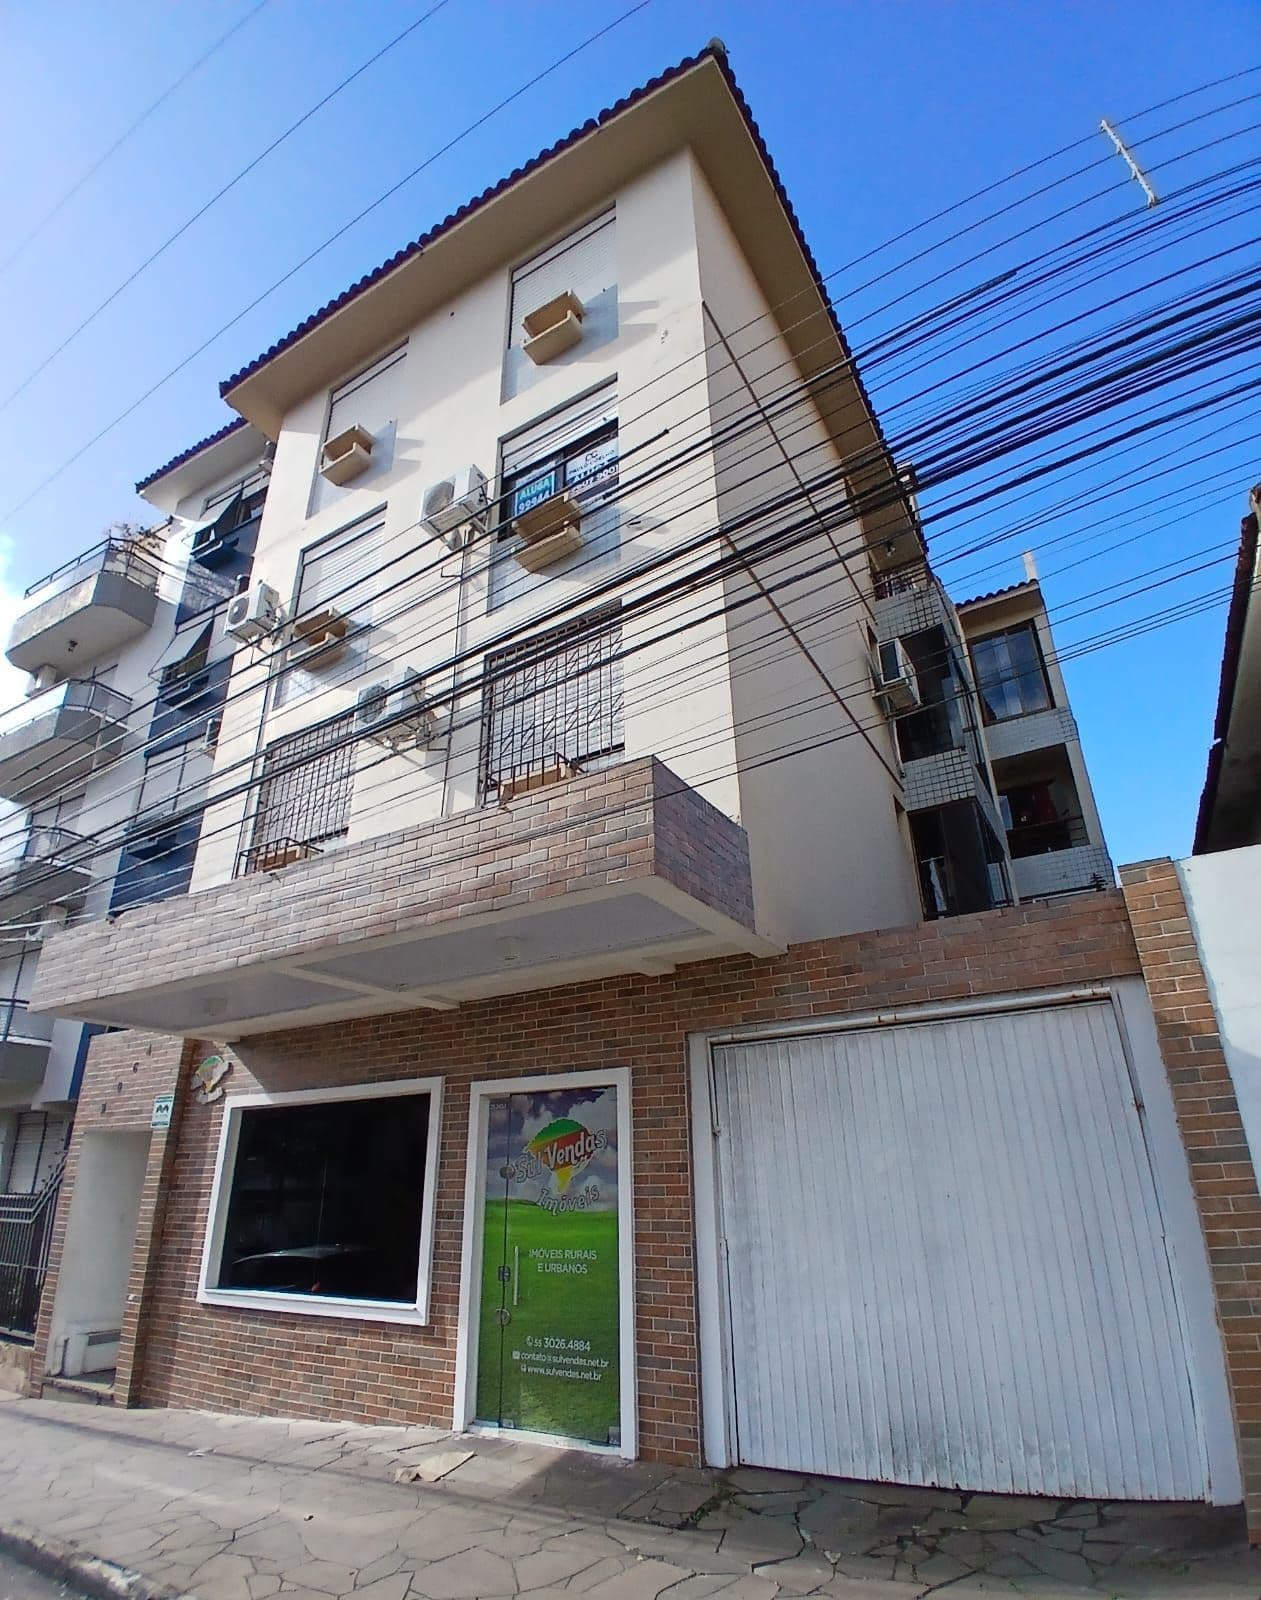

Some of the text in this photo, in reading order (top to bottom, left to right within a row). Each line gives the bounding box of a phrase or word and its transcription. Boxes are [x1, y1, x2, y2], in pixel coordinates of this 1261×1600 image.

[521, 478, 551, 498] ALUGA
[514, 1129, 608, 1183] Sul Vendas
[537, 1184, 600, 1215] Imóveis
[565, 1249, 597, 1260] RURAIS
[538, 1263, 588, 1274] E URBANOS
[534, 1337, 591, 1352] 55 3026.4884
[528, 1367, 602, 1381] www.sulvendas.net.br
